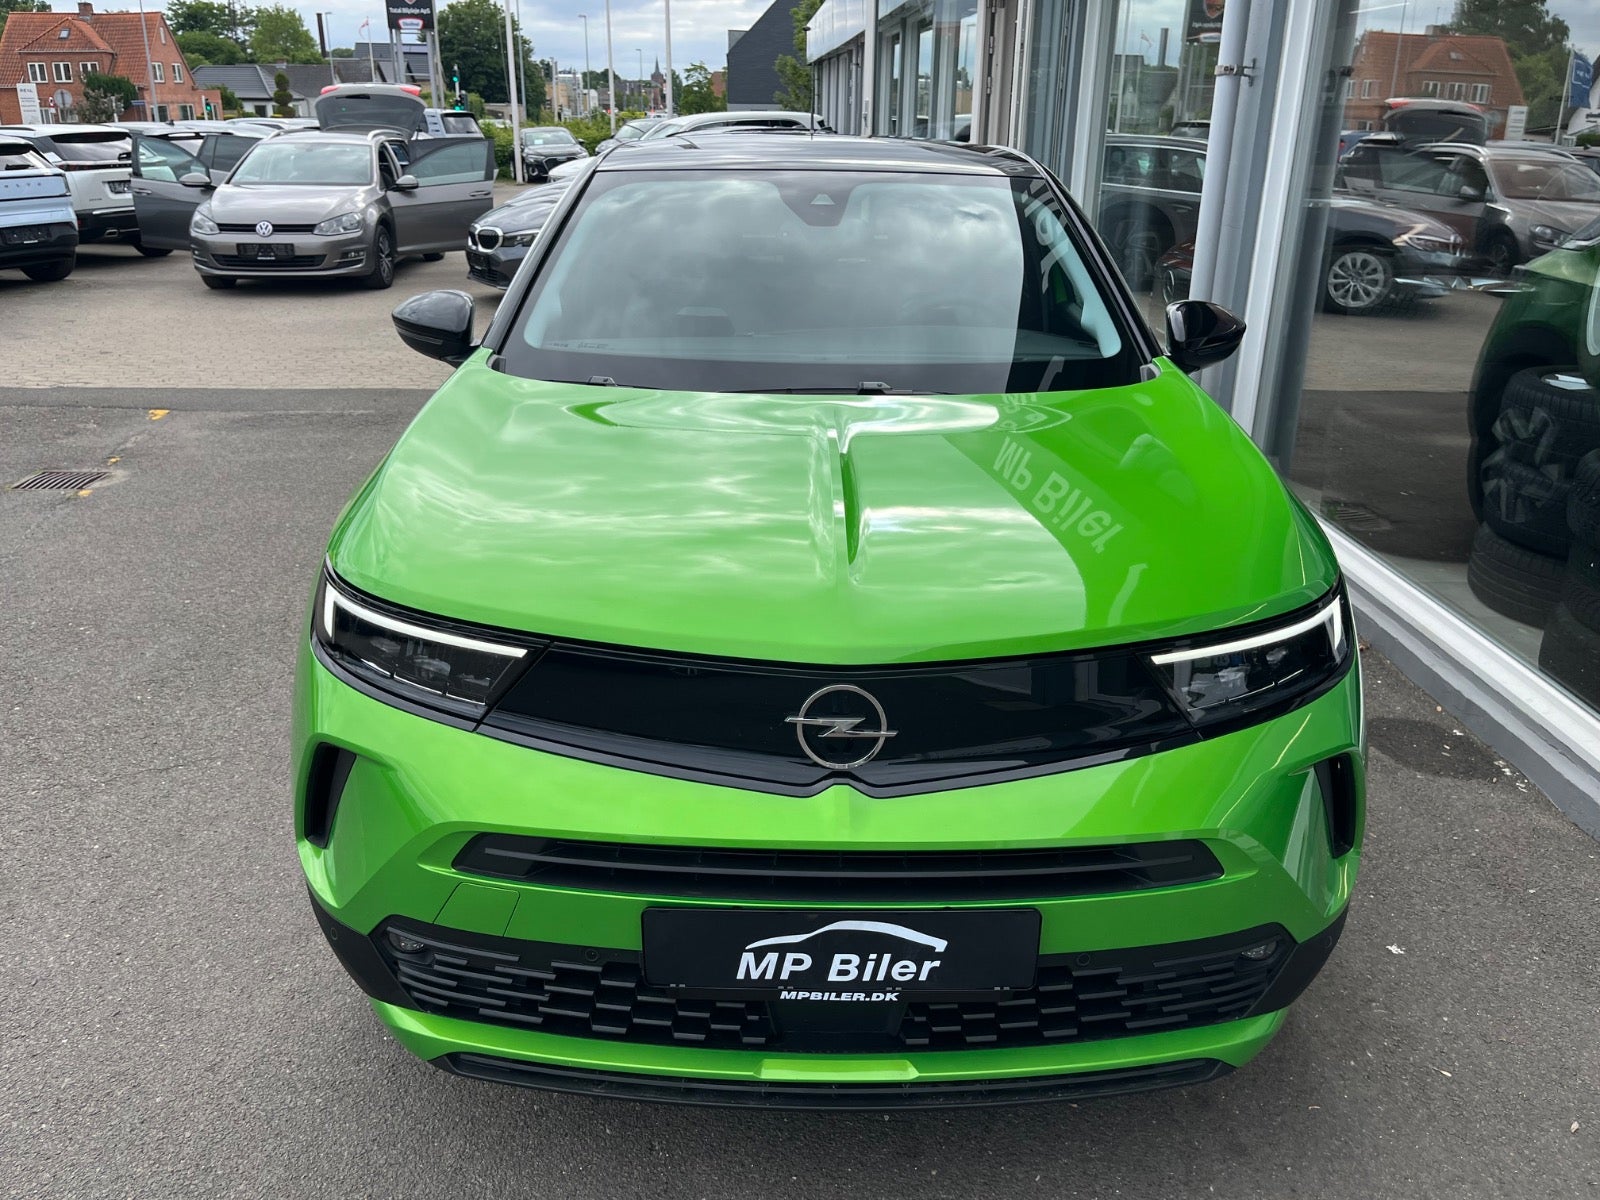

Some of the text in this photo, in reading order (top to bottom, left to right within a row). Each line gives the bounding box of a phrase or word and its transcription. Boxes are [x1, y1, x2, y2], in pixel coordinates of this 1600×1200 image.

[736, 952, 941, 982] MP Biler
[779, 990, 900, 1002] MPBILER.DK
